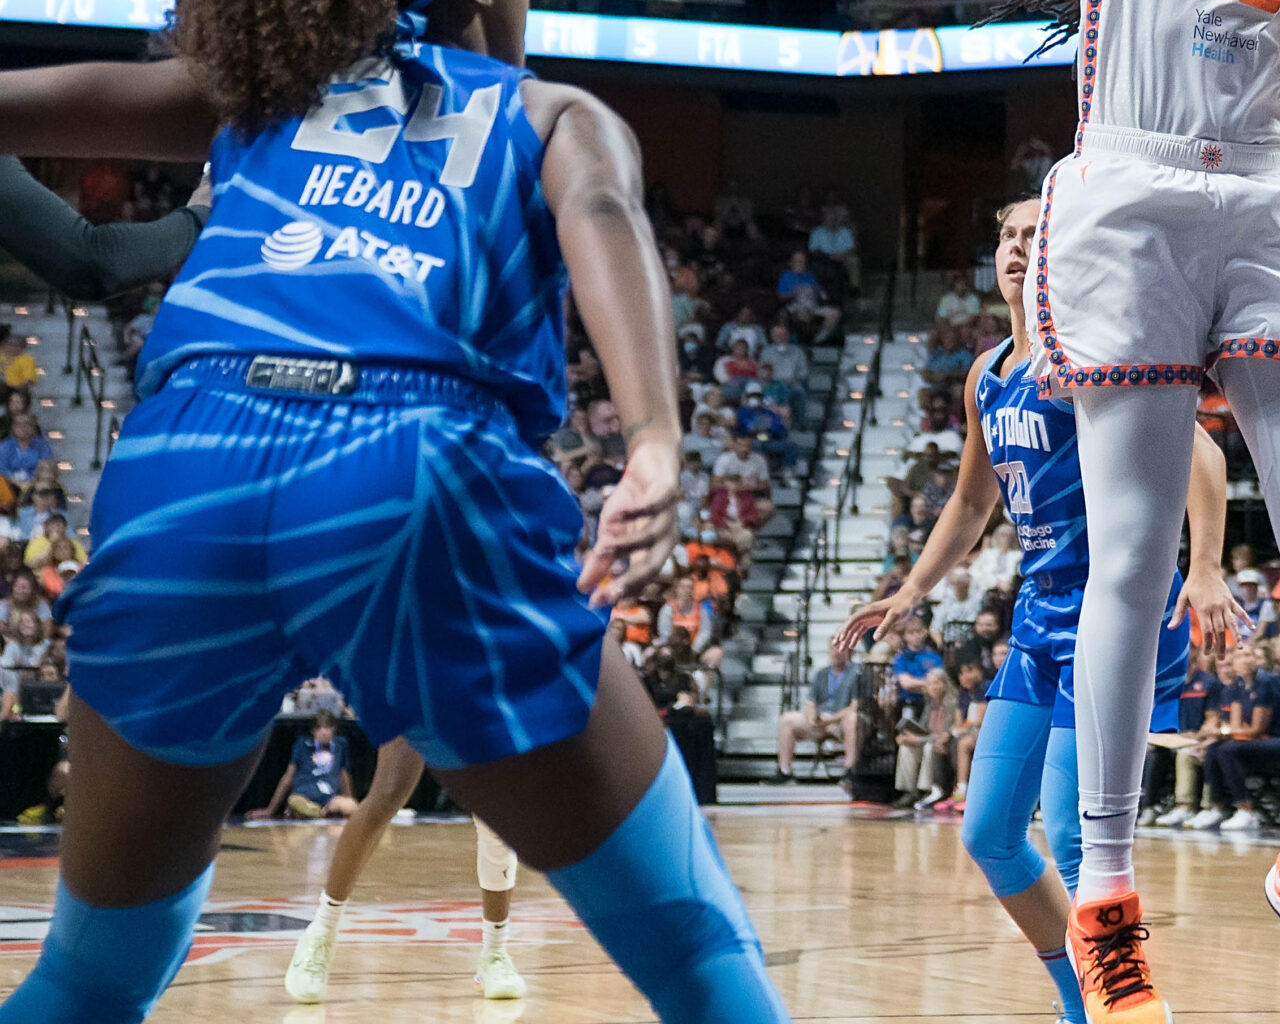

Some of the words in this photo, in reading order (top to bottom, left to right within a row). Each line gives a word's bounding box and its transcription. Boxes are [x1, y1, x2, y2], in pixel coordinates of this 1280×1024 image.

[1195, 8, 1222, 27] Yale
[634, 25, 657, 57] 5
[698, 32, 742, 65] FTA
[778, 37, 801, 67] 5
[1192, 42, 1235, 64] Health
[291, 58, 503, 189] 24
[299, 164, 446, 228] HEBARD
[325, 227, 446, 283] AT&T
[992, 461, 1033, 514] 20
